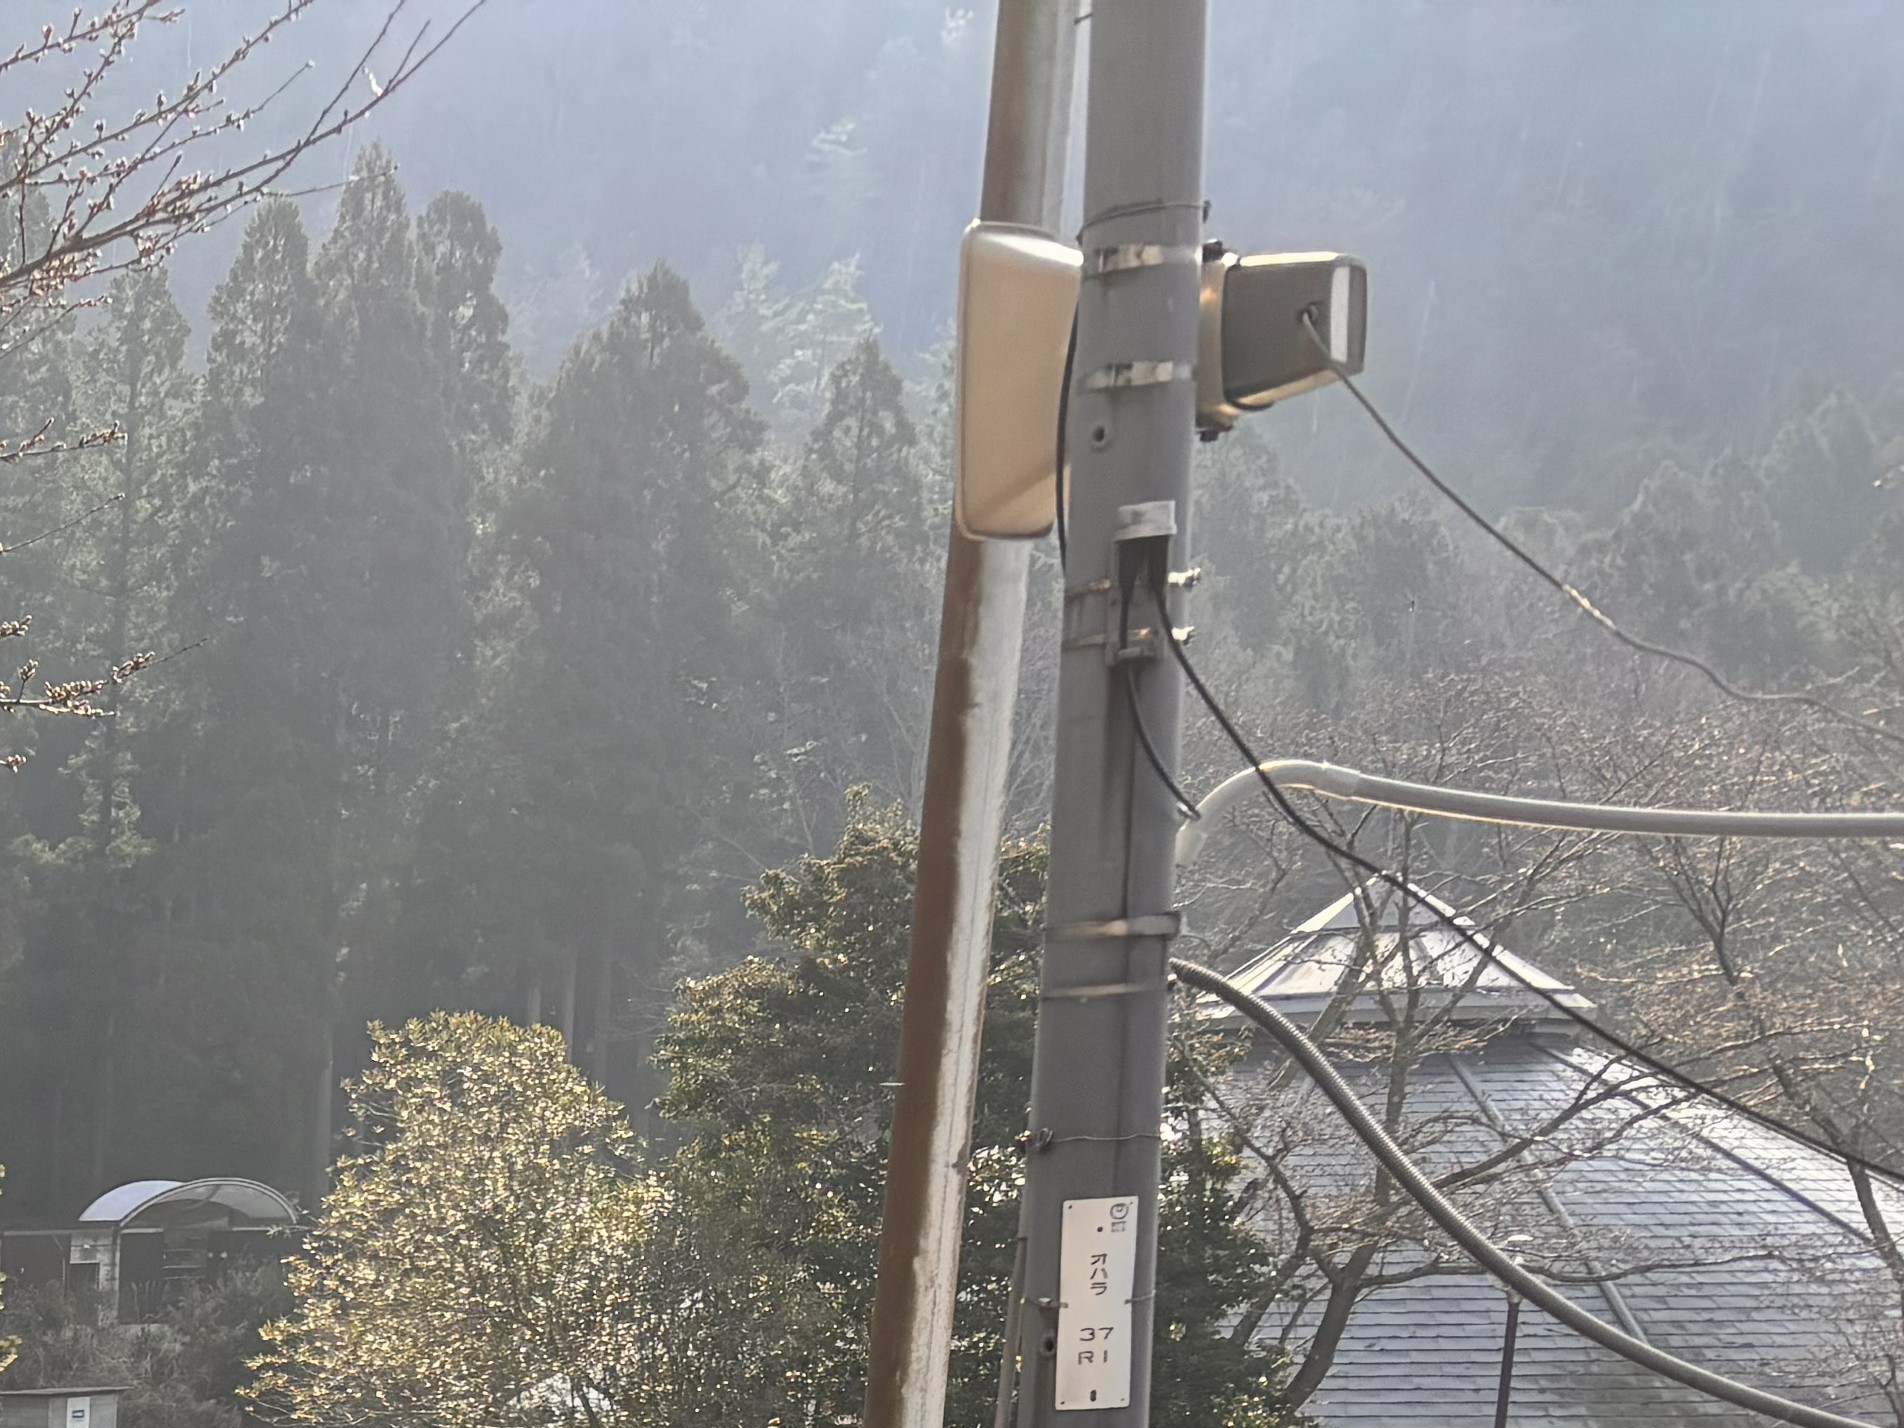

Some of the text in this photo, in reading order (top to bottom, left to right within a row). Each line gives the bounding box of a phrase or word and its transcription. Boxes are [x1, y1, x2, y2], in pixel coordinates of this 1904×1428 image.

[1090, 1253, 1108, 1296] オハラ
[1080, 1326, 1114, 1341] 37
